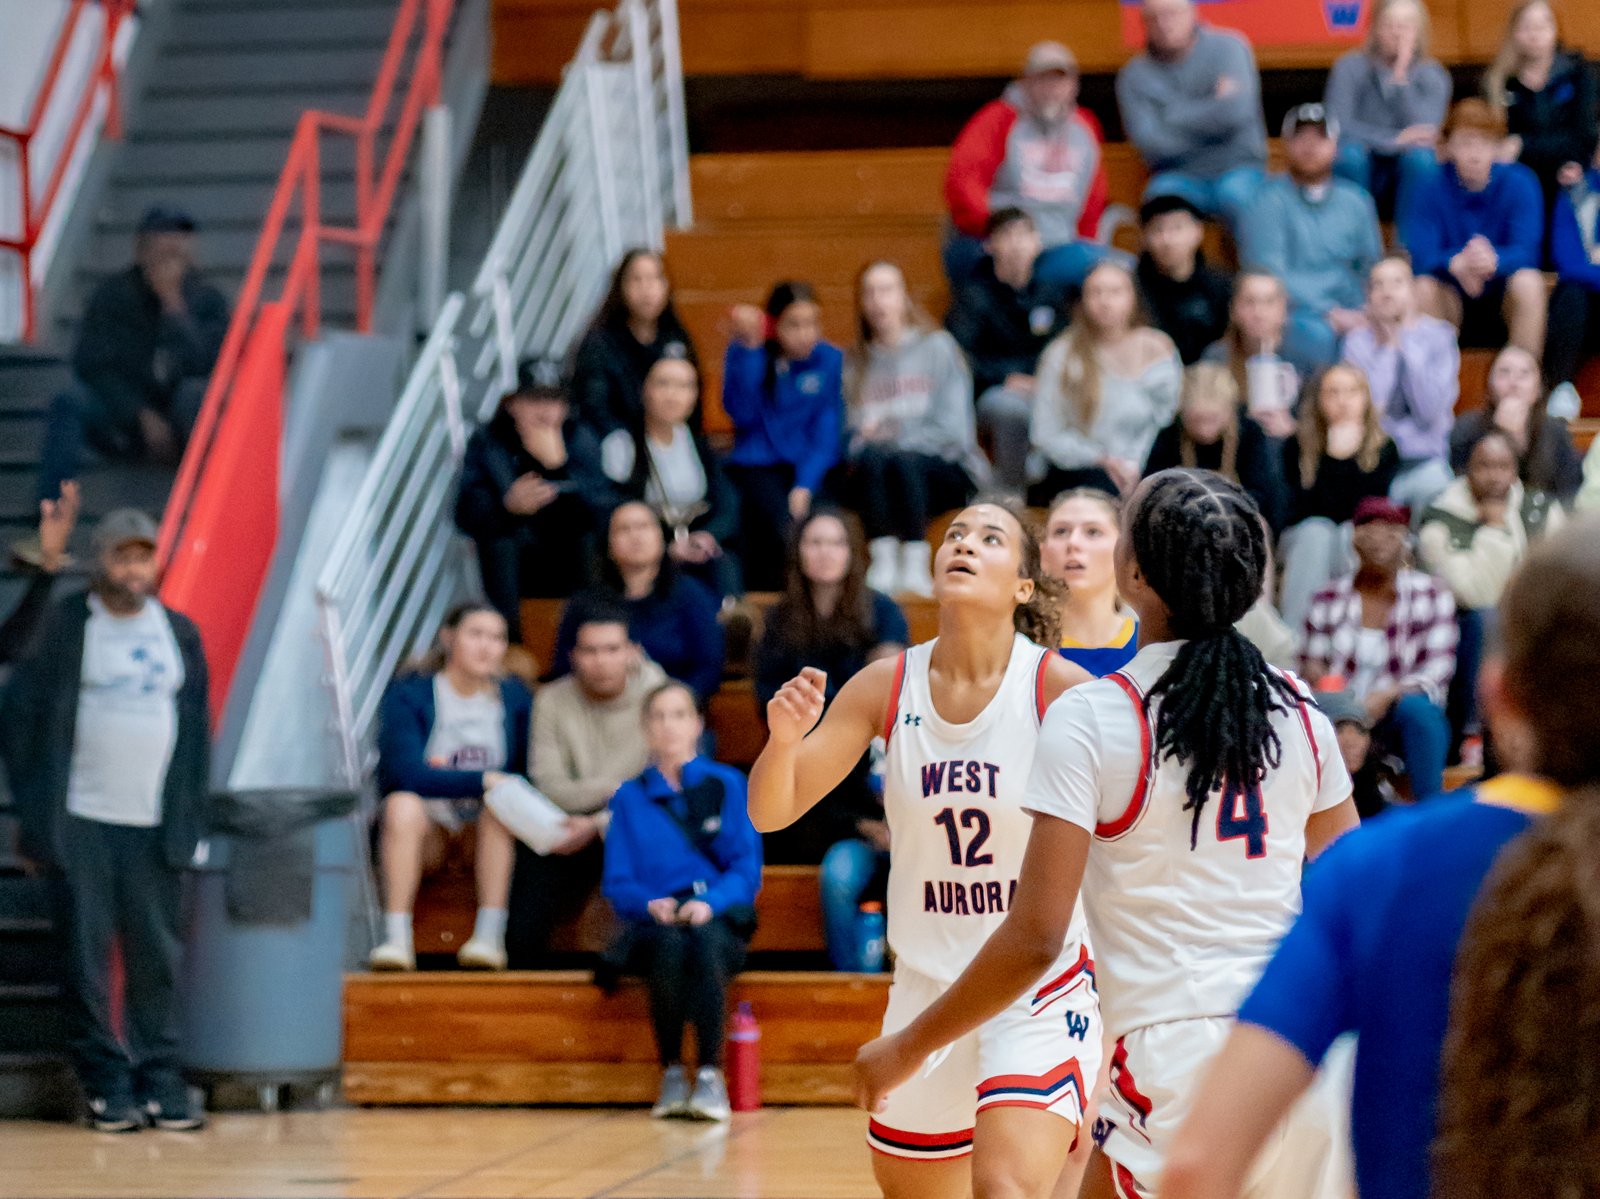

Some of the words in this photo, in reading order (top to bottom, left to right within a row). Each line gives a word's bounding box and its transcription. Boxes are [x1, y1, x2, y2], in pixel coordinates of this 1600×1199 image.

[921, 760, 1000, 798] WEST
[934, 807, 993, 867] 12
[1216, 768, 1268, 860] 4
